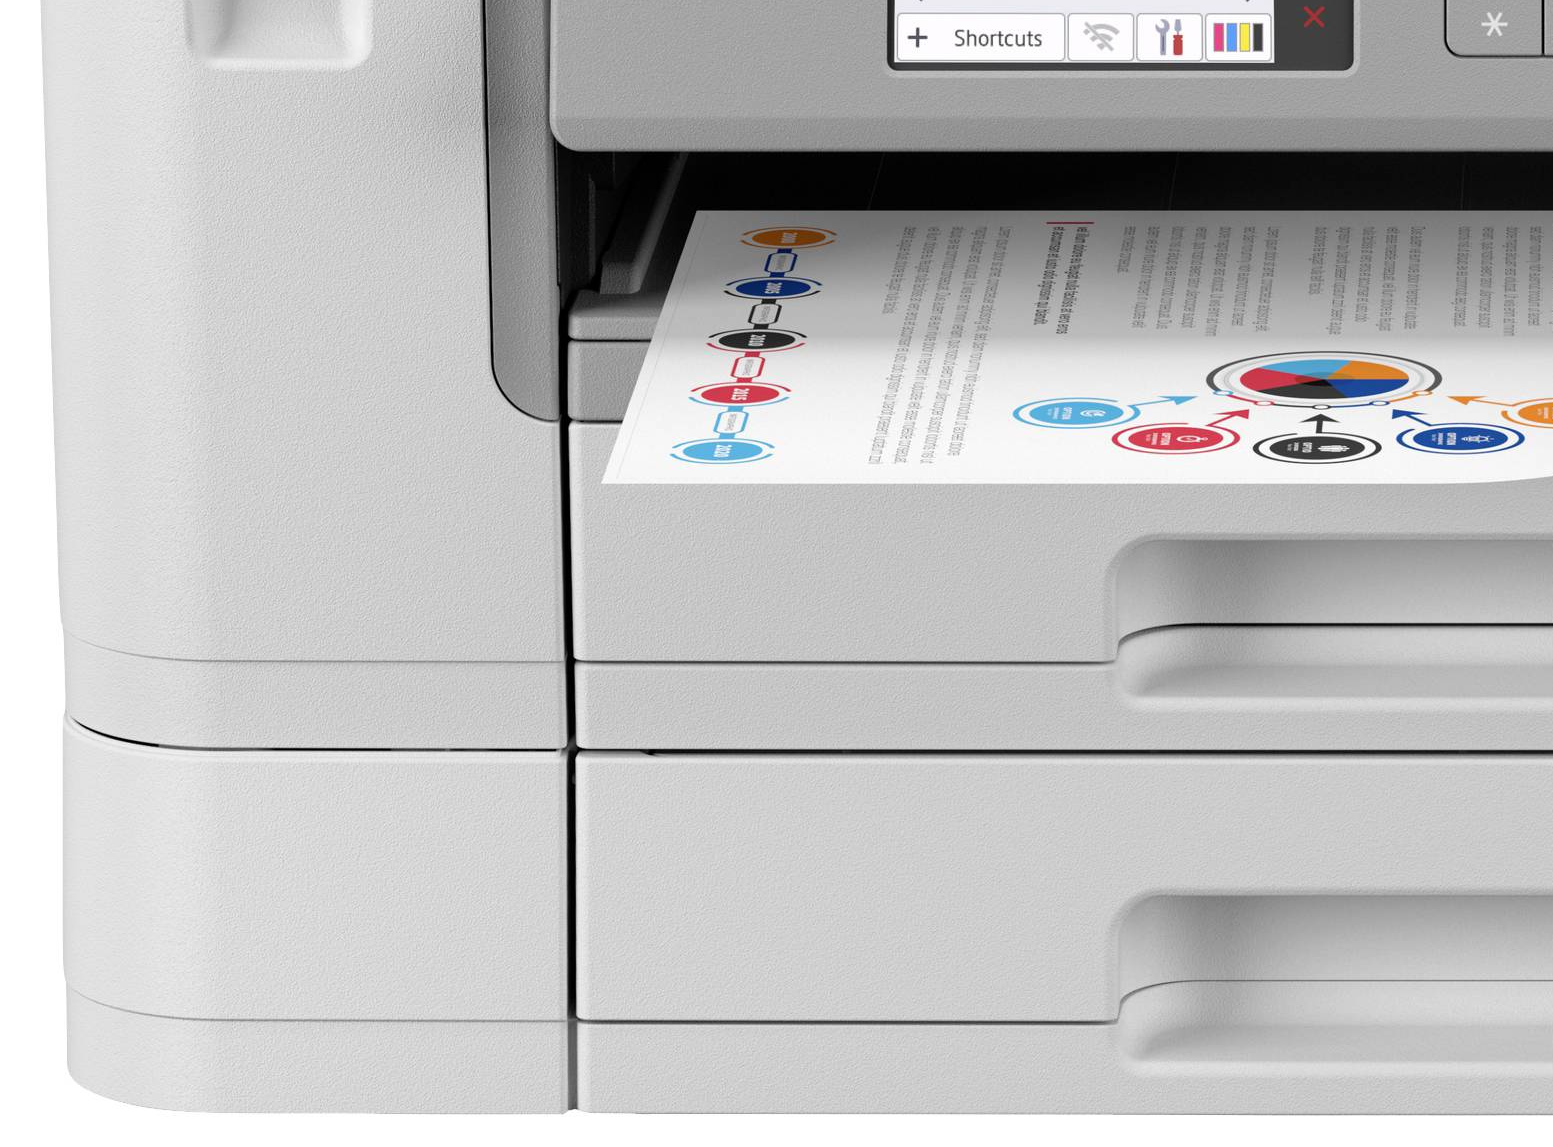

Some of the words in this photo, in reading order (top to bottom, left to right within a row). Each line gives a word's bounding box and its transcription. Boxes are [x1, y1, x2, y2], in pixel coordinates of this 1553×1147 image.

[954, 28, 1043, 48] Shortcuts
[748, 333, 766, 348] 2010
[731, 387, 749, 402] 2015
[713, 444, 732, 459] 2020
